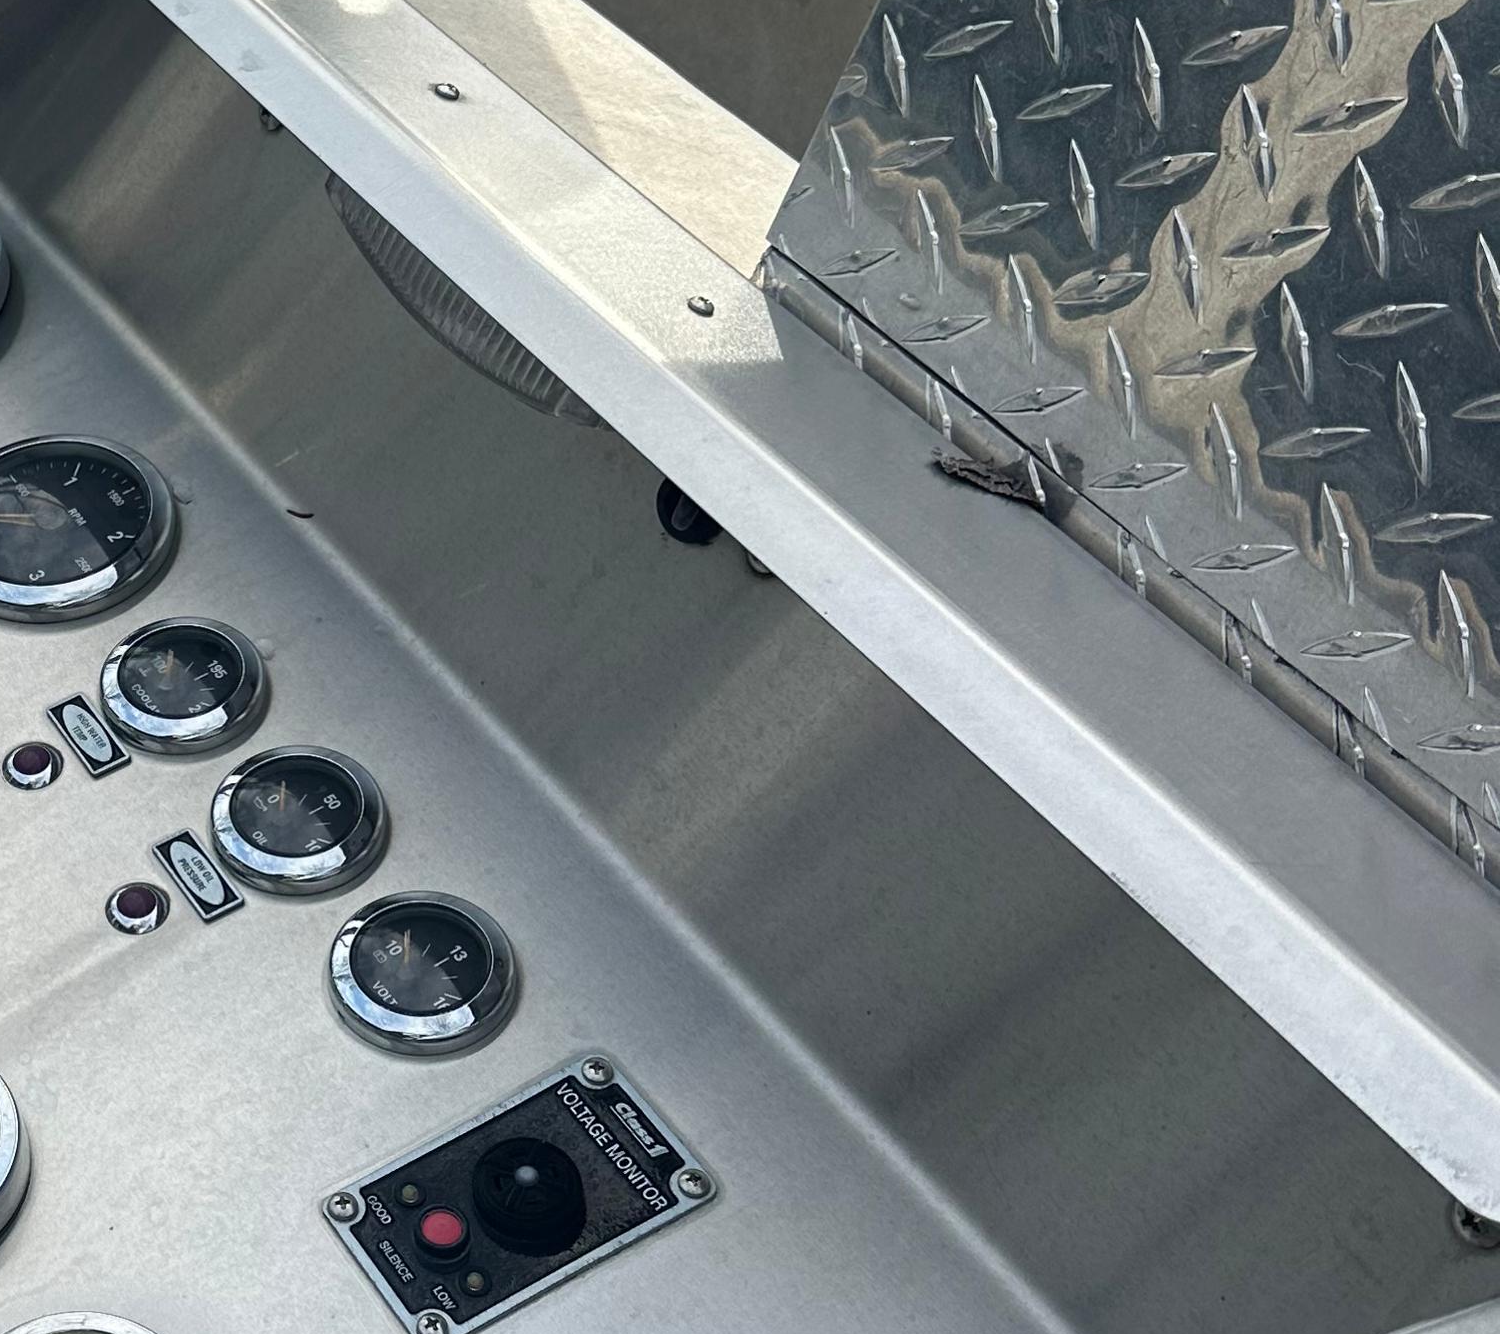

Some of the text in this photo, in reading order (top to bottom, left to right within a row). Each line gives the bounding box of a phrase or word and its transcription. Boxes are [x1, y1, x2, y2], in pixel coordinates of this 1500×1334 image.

[63, 476, 79, 487] 1
[107, 489, 124, 507] 1500
[67, 508, 88, 527] RPM
[107, 531, 124, 543] 2
[29, 570, 45, 581] 3
[207, 659, 228, 679] 195
[131, 684, 160, 713] COOLA
[72, 726, 88, 742] TEMP
[77, 713, 107, 749] HIGH WATER
[267, 794, 280, 804] 0
[323, 794, 341, 810] 50
[252, 831, 269, 846] OIL
[304, 839, 322, 852] 10
[178, 858, 207, 892] PRESSURE
[190, 856, 215, 884] LOW OIL
[385, 940, 403, 956] 10
[449, 945, 468, 962] 13
[372, 980, 398, 1006] VOLT
[557, 1083, 668, 1211] VOLTAGE MONITOR
[367, 1196, 392, 1225] GOOD
[379, 1240, 414, 1283] SILENCE
[433, 1285, 457, 1311] LOW
